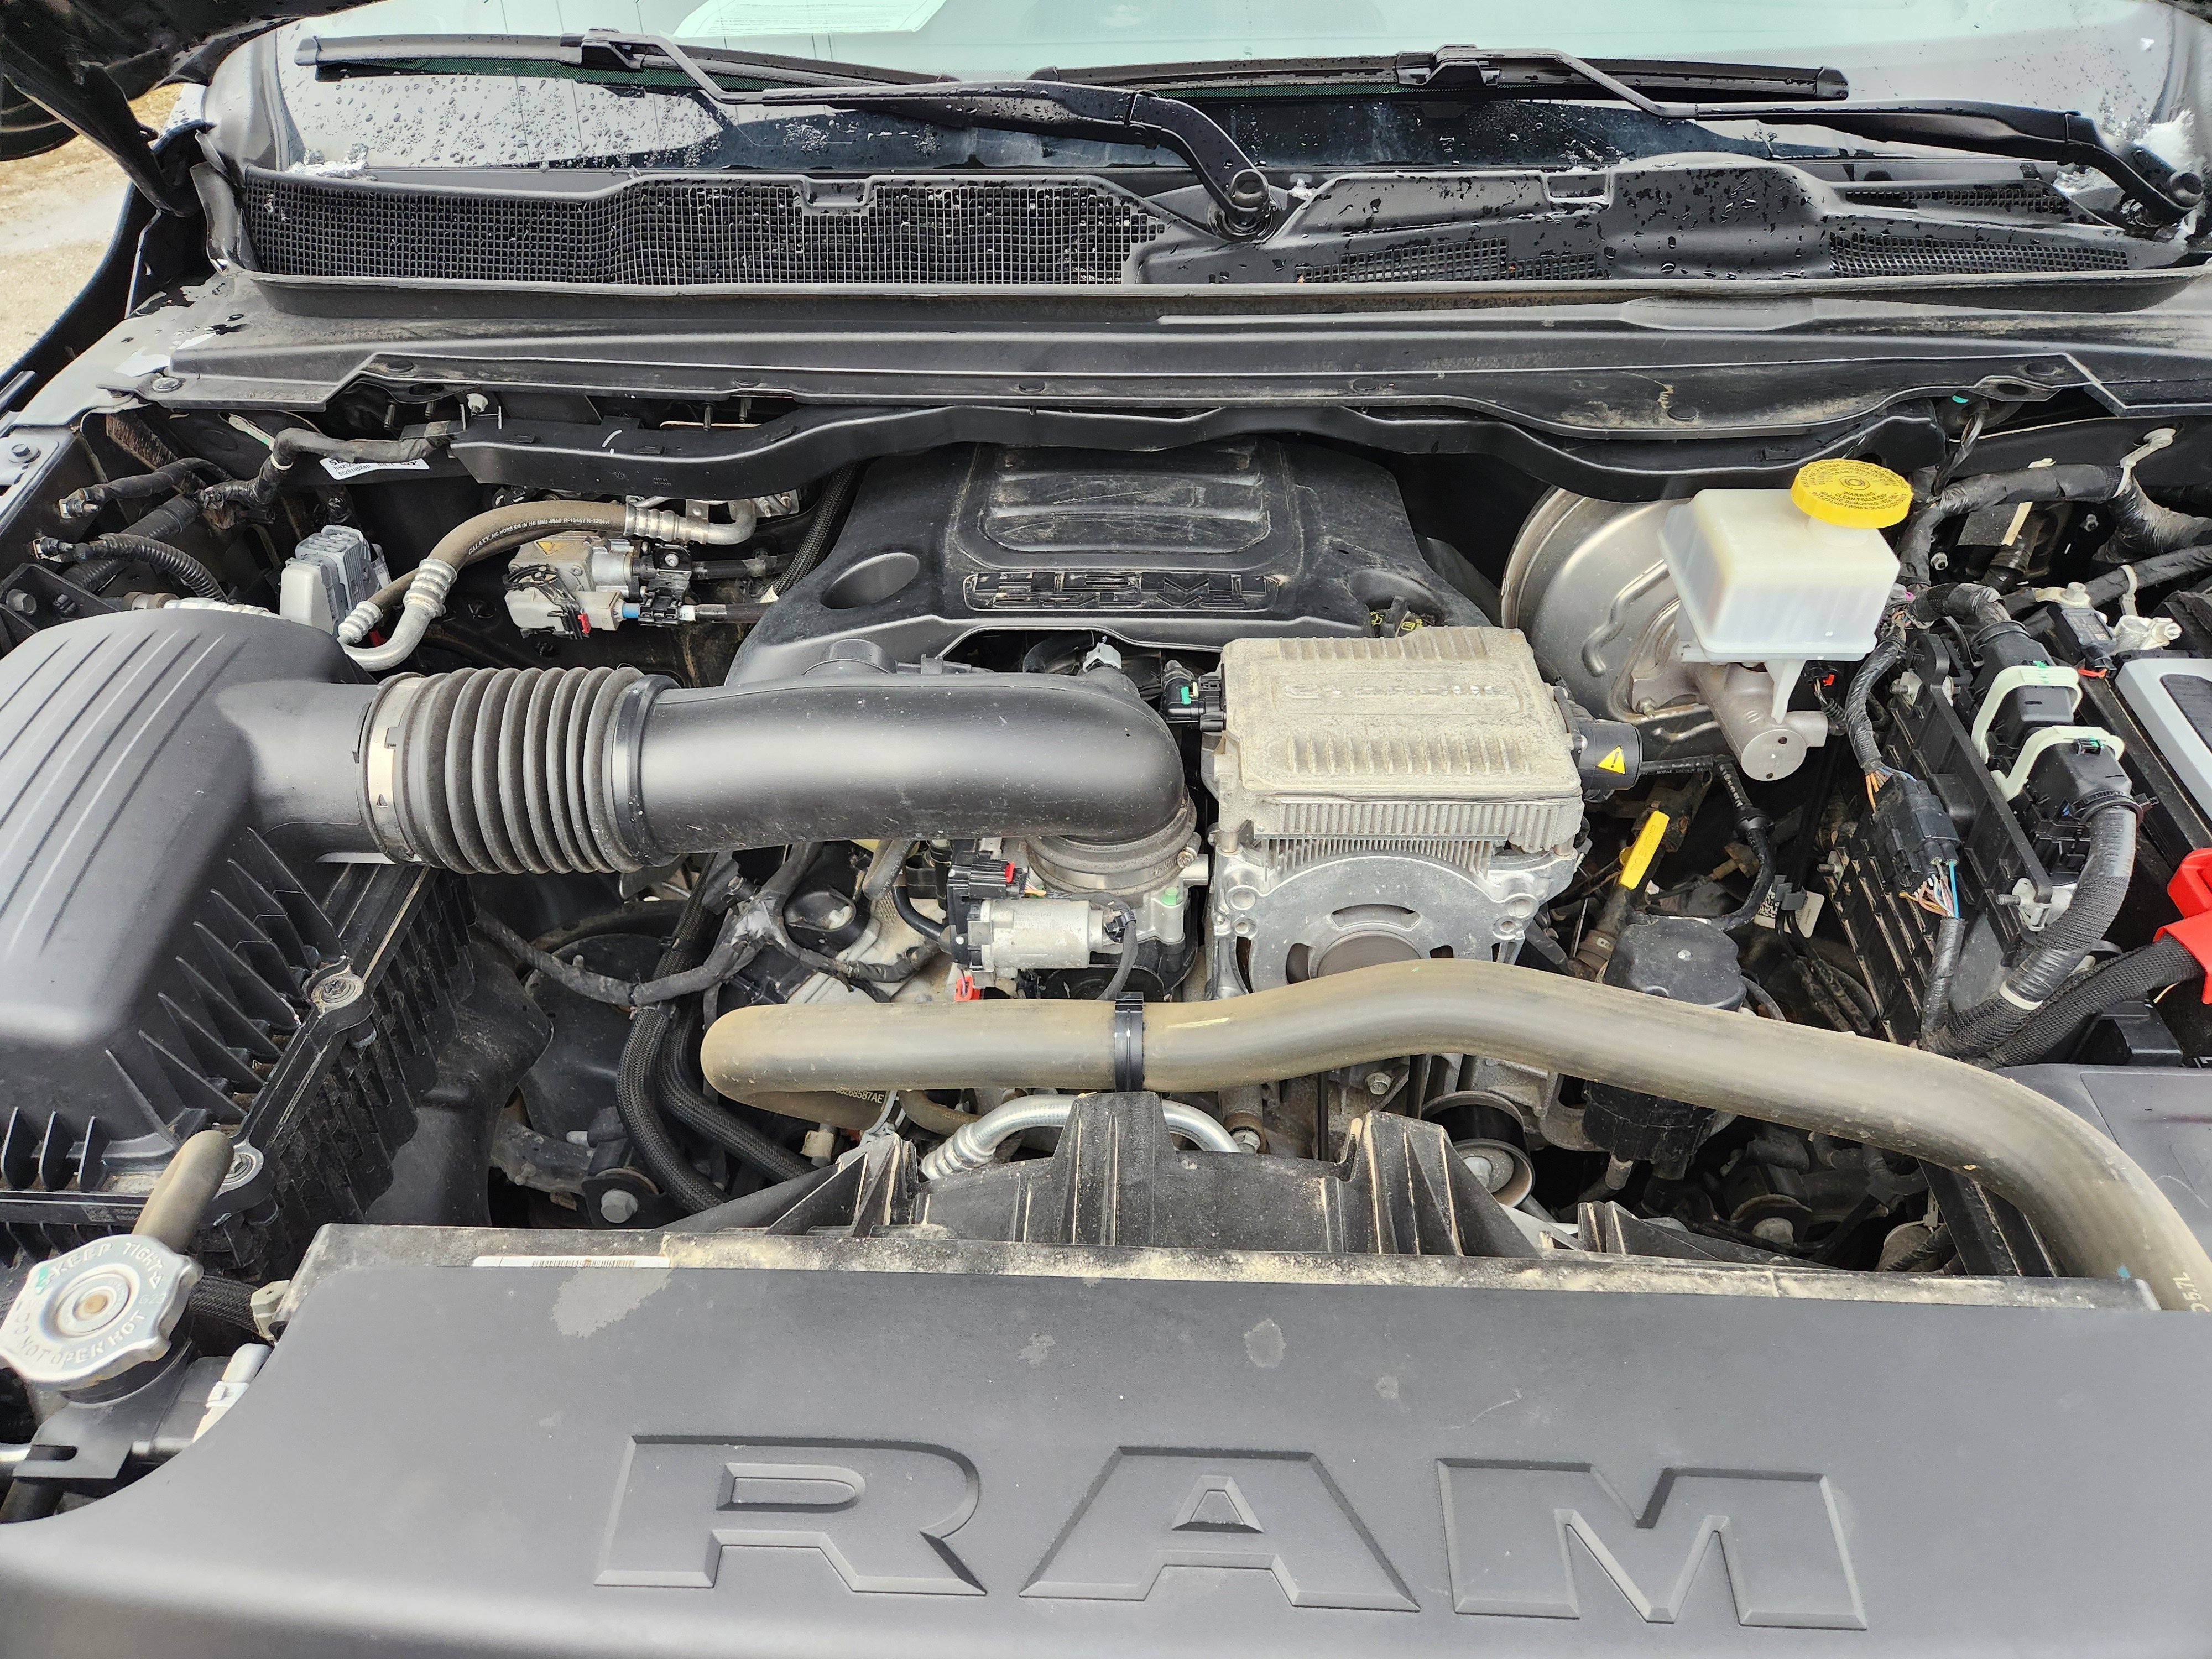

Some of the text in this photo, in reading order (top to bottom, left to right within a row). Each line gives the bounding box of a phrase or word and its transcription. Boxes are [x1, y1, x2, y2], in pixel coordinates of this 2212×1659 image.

[1819, 491, 1843, 502] BEFORE
[468, 535, 490, 555] GALAXY
[499, 526, 513, 535] HOSE
[54, 1241, 165, 1277] KEEP TIGHT
[2172, 1272, 2203, 1301] 5.7L
[21, 1336, 51, 1362] NOT
[50, 1341, 105, 1365] OPEN
[108, 1308, 146, 1347] HOT
[593, 1433, 1868, 1631] RAM
